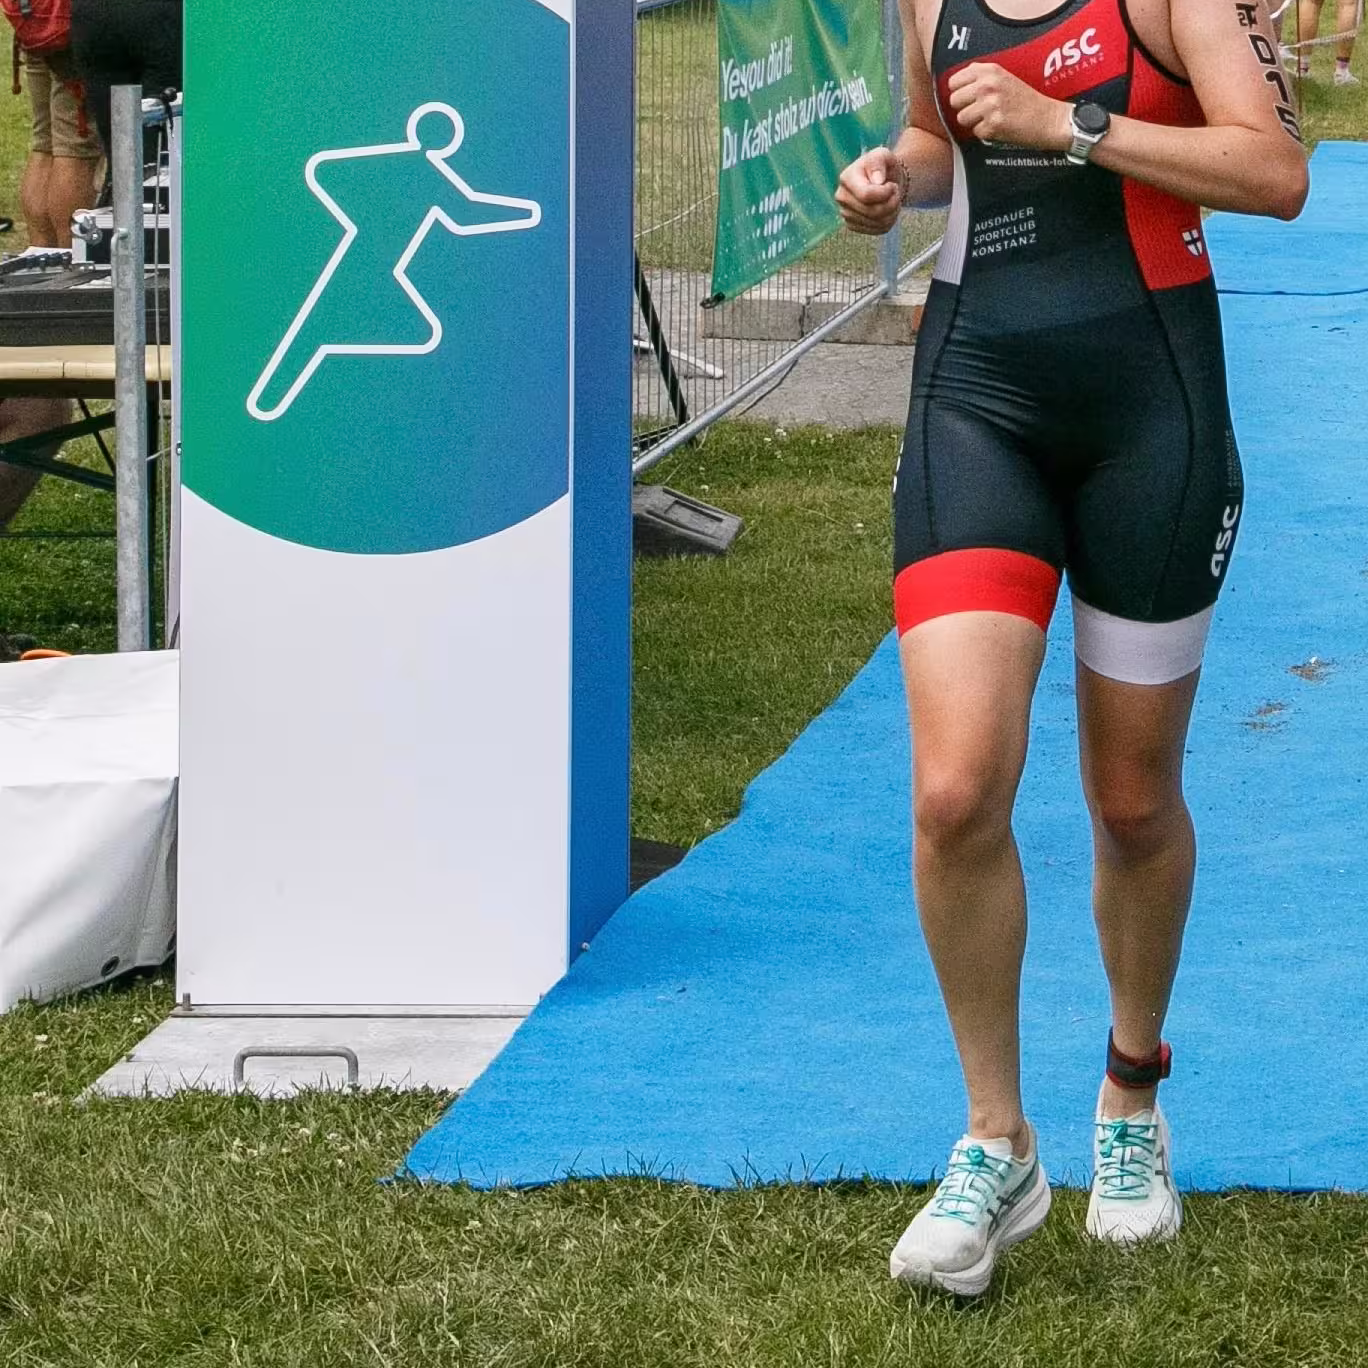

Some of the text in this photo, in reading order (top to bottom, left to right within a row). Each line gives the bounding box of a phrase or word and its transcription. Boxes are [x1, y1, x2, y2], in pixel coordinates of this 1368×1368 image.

[1044, 28, 1101, 78] ASC
[774, 96, 799, 144] stolz
[817, 78, 850, 121] dich
[973, 219, 1036, 245] SPORTCLUB
[974, 206, 1035, 232] AUSDAUER
[971, 233, 1037, 258] KONSTANZ
[1210, 503, 1239, 577] ASC
